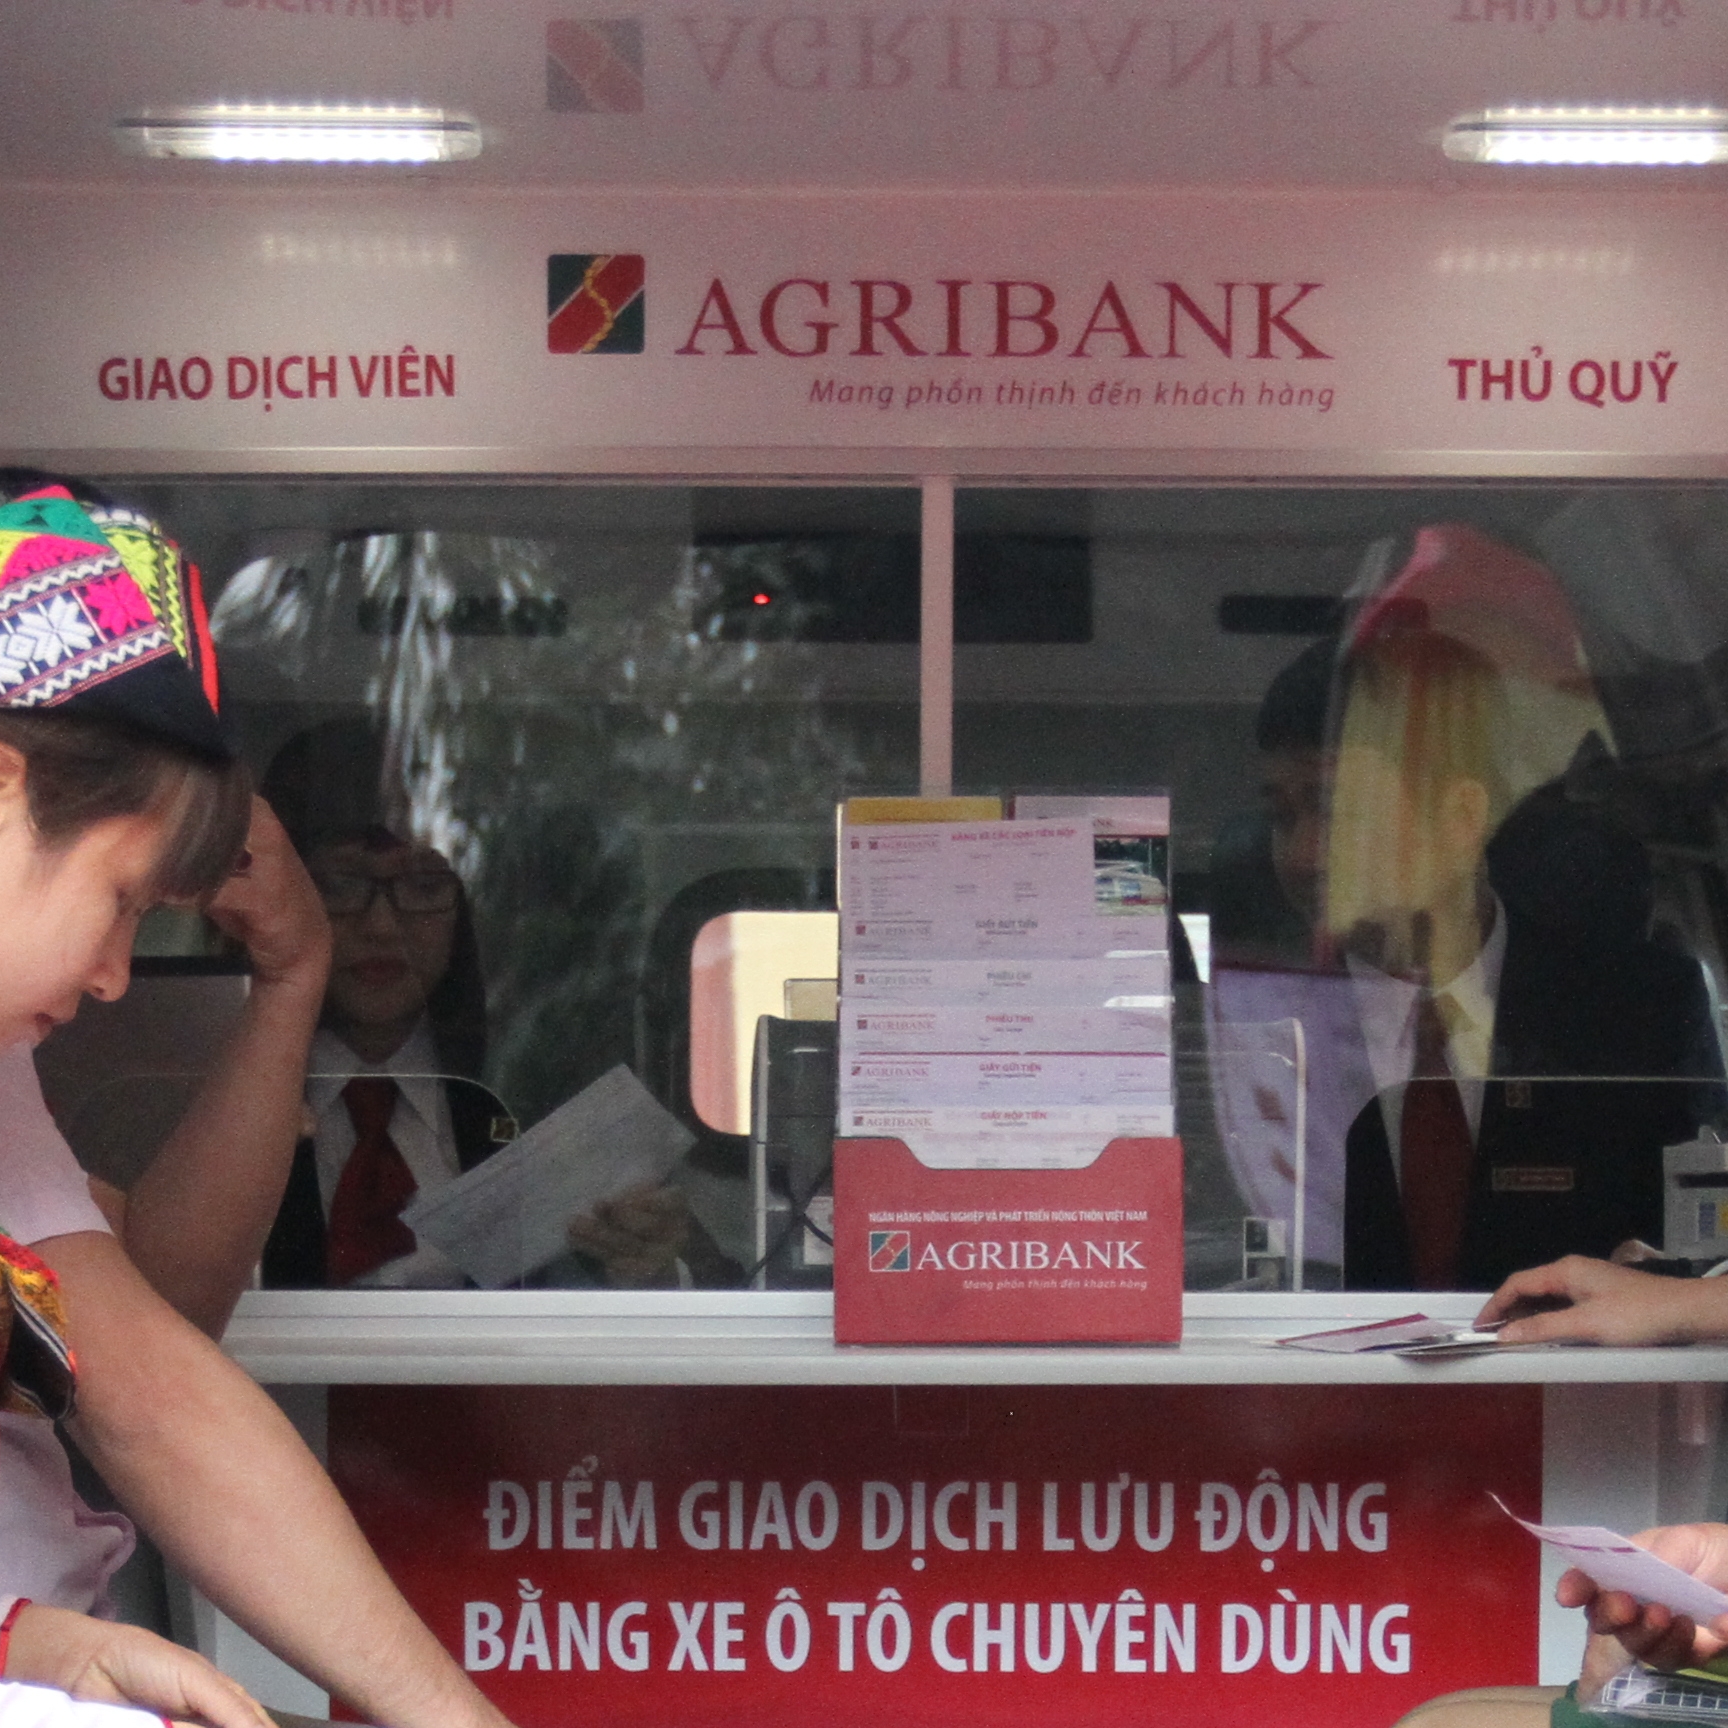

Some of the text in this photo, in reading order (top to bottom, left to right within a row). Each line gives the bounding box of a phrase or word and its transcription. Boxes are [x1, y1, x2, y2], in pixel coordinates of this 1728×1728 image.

[674, 278, 1335, 359] AGRIBANK
[98, 344, 456, 412] GIAO DỊCH VIÊN
[809, 380, 894, 410] Mang
[996, 379, 1075, 410] thịnh
[1091, 379, 1142, 406] đến
[1154, 381, 1245, 407] khách
[1257, 382, 1335, 412] hàng
[1447, 345, 1679, 409] THỦ QUỸ
[869, 1210, 894, 1222] NGÂN
[896, 1210, 922, 1222] HÀNG
[1126, 1210, 1148, 1222] NAM
[916, 1241, 1147, 1270] AGRIBANK
[482, 1455, 1388, 1572] ĐIỂM GIAO DỊCH LƯU ĐỘNG
[464, 1578, 1411, 1674] BẰNG XE Ô TÔ CHUYÊN DÙNG
